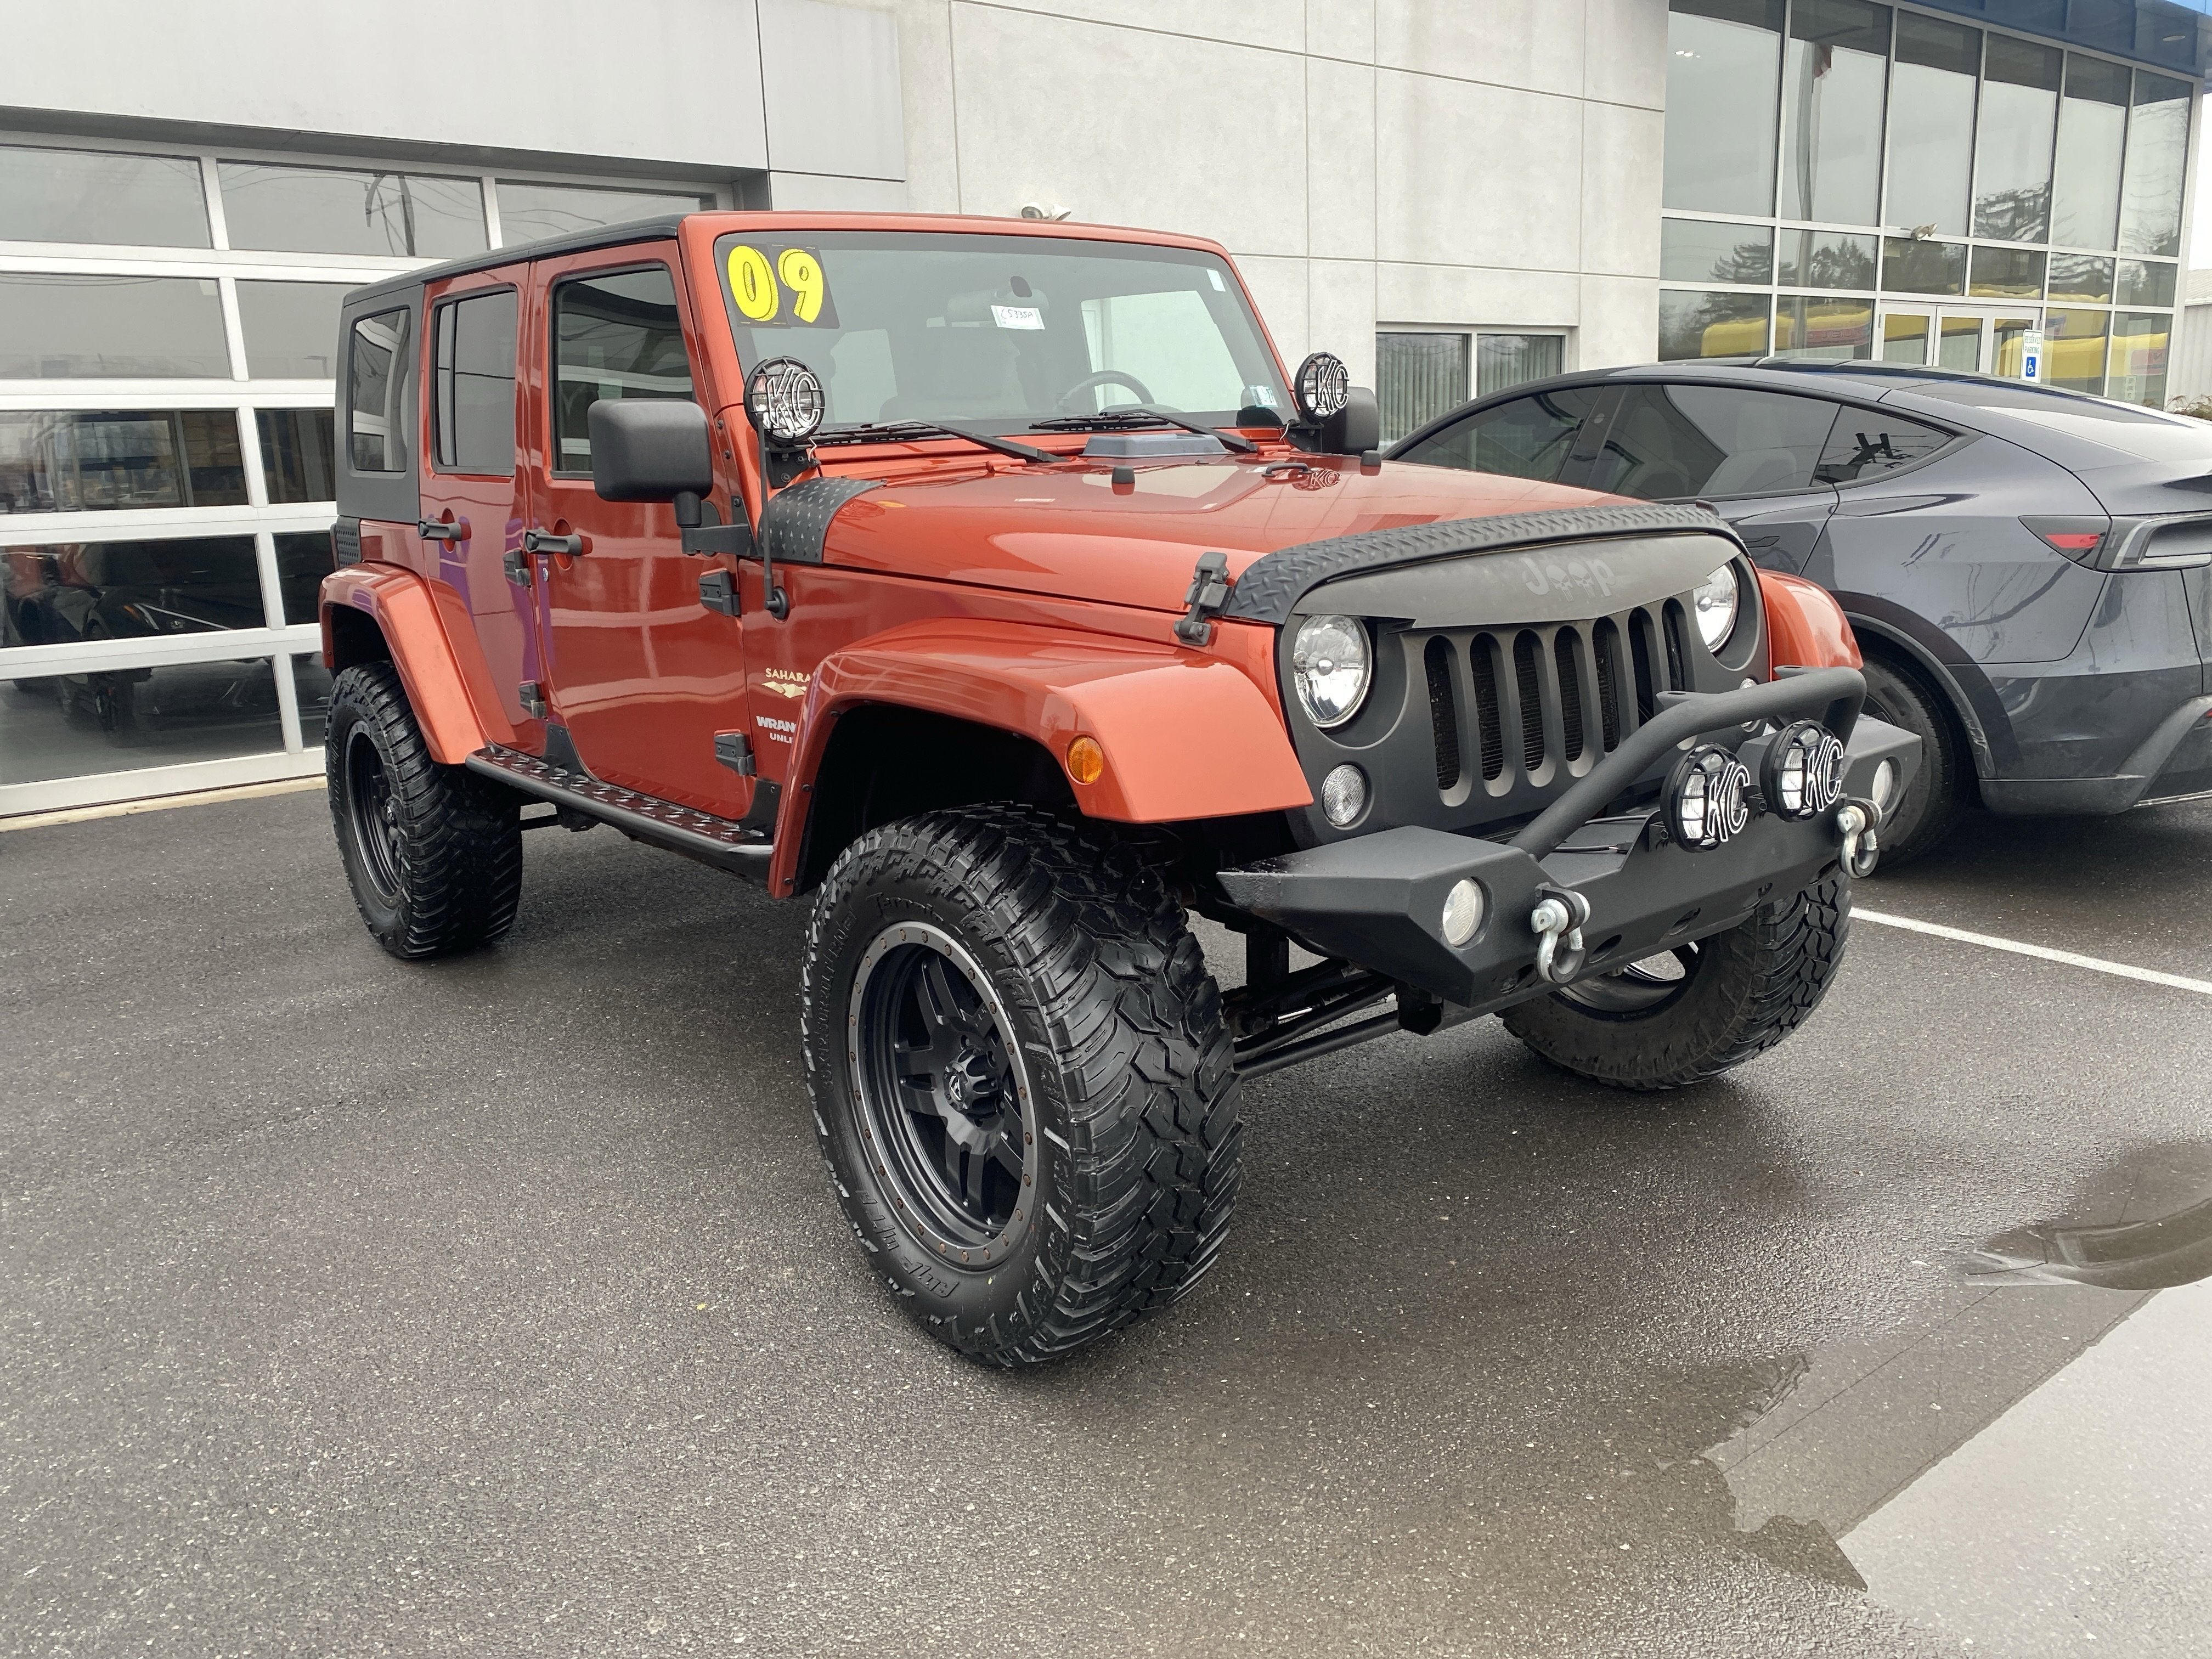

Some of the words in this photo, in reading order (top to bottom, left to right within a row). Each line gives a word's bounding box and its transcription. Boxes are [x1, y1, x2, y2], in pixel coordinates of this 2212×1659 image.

[727, 245, 823, 323] 09
[2024, 346, 2040, 354] PARKING
[766, 367, 820, 433] KC
[1318, 360, 1349, 413] KC
[765, 668, 811, 683] SAHARA
[756, 715, 796, 733] WRAN
[769, 732, 793, 744] UNLI
[1805, 735, 1844, 812] KC
[1707, 761, 1750, 842] KC
